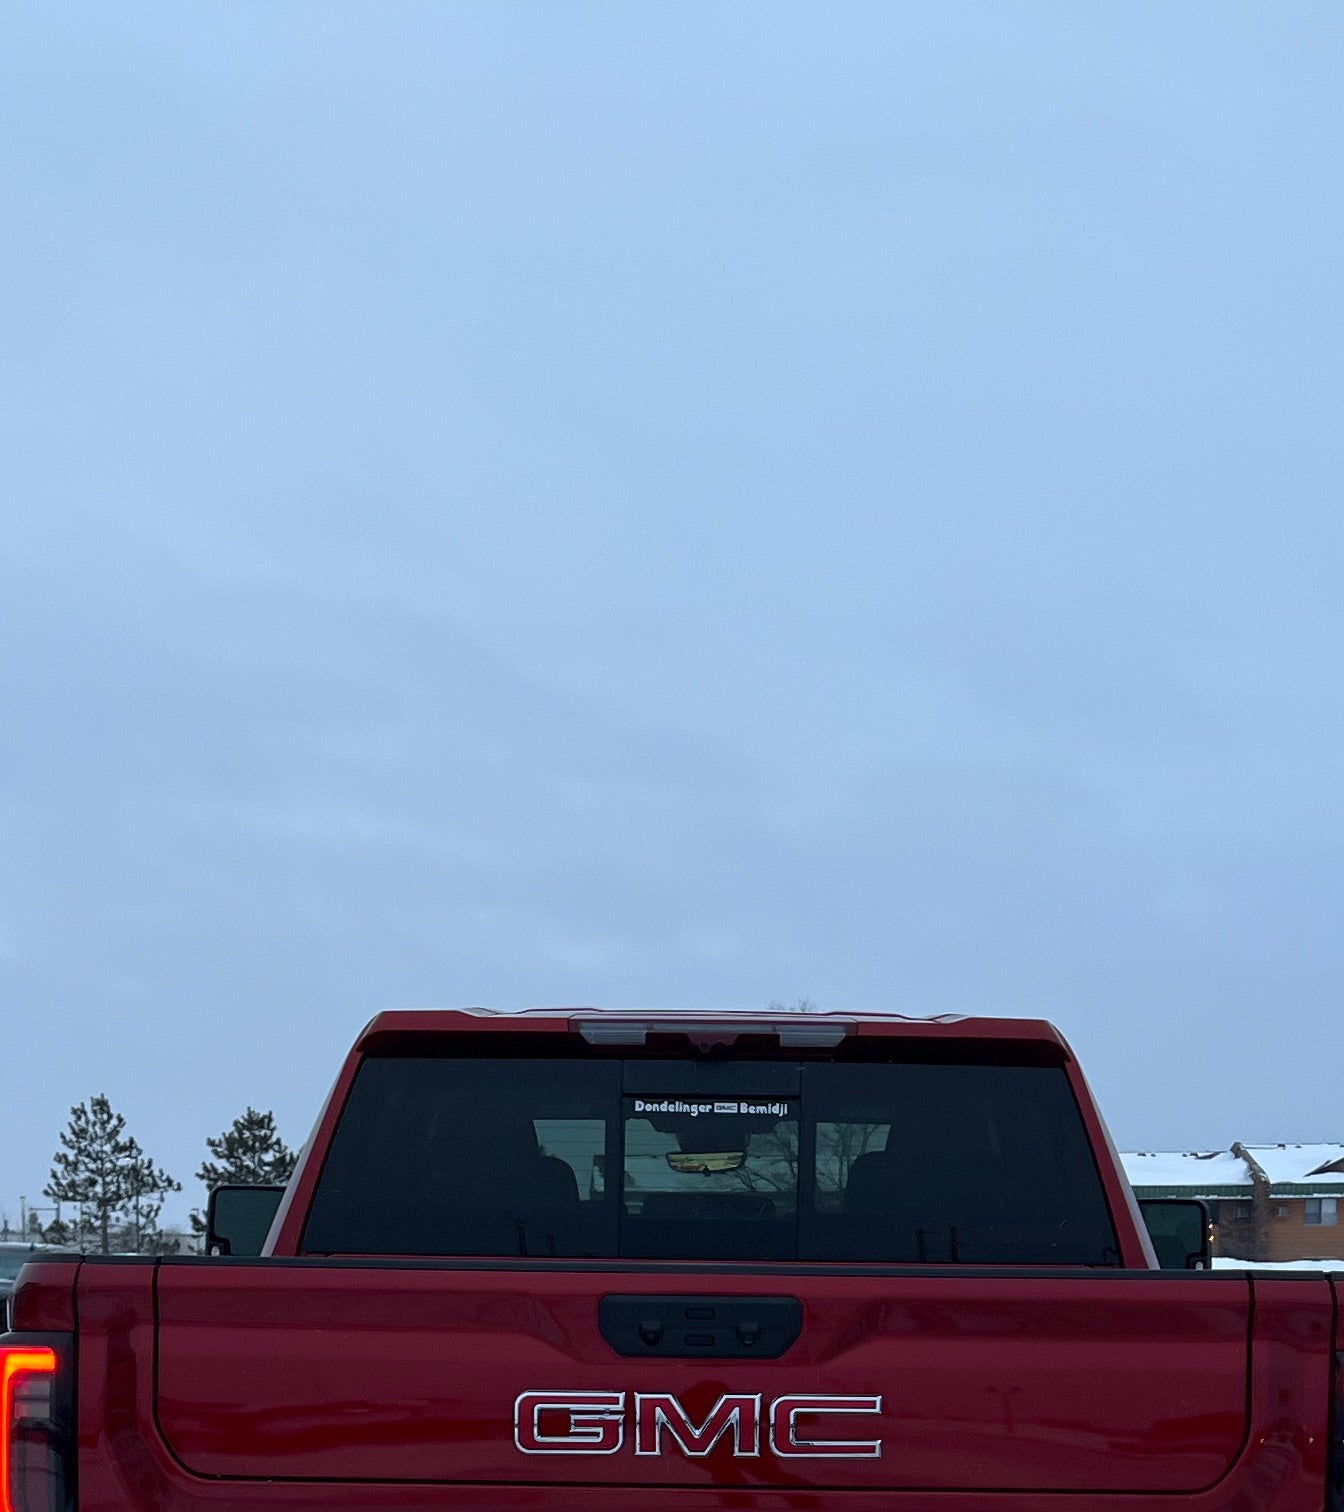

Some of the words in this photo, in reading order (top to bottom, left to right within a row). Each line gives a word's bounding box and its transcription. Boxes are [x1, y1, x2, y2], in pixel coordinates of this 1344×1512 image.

[634, 1100, 713, 1117] Dondelinger
[739, 1102, 788, 1117] Bemidji
[514, 1389, 882, 1458] GMC
